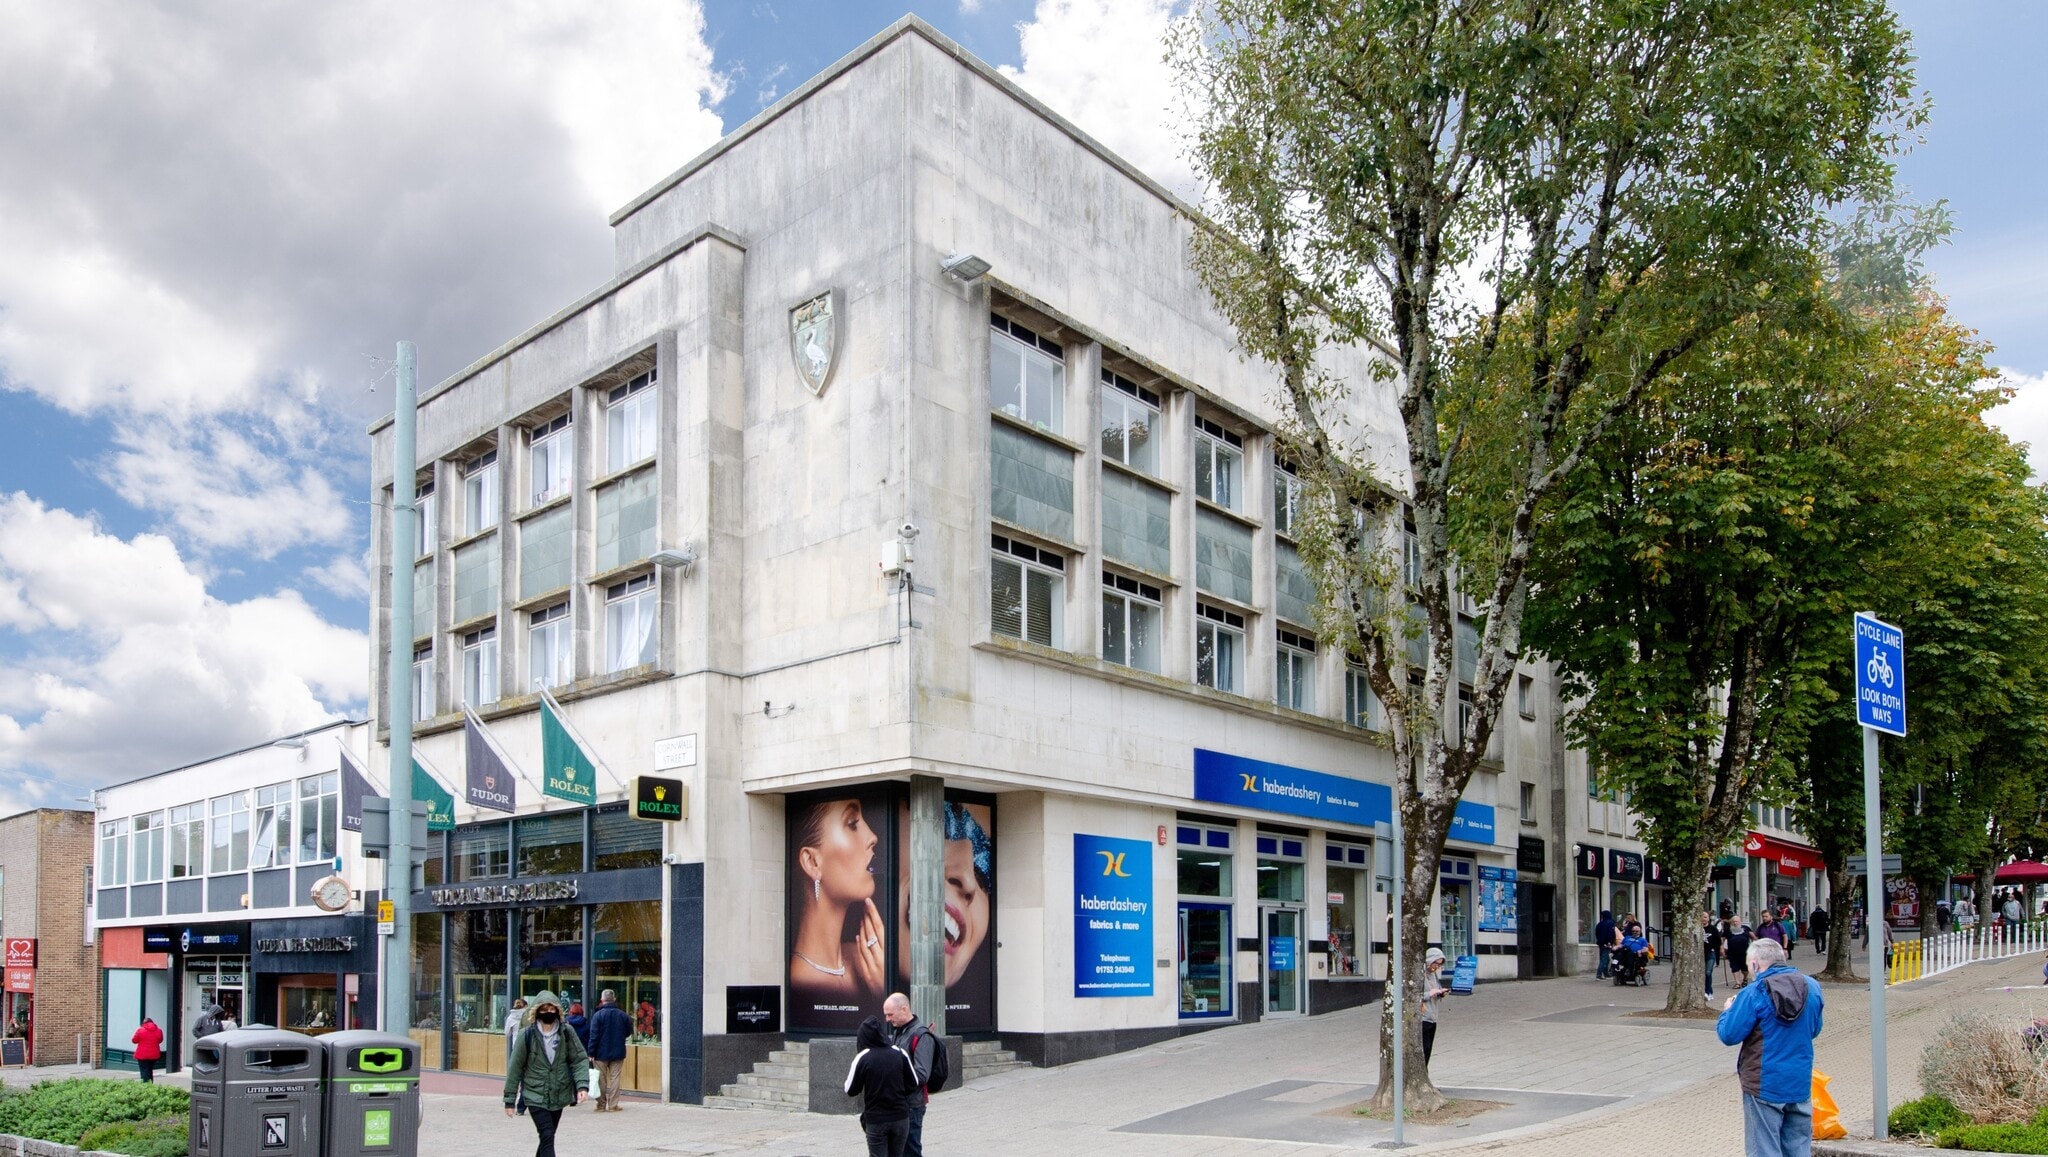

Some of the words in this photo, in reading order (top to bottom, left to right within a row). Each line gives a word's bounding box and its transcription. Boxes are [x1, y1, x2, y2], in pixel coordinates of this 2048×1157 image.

[1859, 621, 1881, 642] CYCLE
[1883, 631, 1901, 649] LANE
[1861, 687, 1881, 705] LOOK
[1882, 693, 1901, 710] BOTH
[1872, 706, 1892, 724] WAYS
[657, 739, 693, 754] CORNWALL
[663, 753, 686, 765] STREET
[549, 777, 591, 796] ROLEX
[1263, 777, 1321, 804] haberdashery
[1327, 796, 1342, 805] fabrics
[1343, 798, 1347, 806] &
[471, 787, 509, 805] TUDOR
[640, 801, 680, 814] ROLEX
[426, 813, 450, 823] LEX
[1784, 857, 1800, 869] Santander
[1080, 894, 1147, 915] haberdashery
[1089, 919, 1114, 930] fabrics
[1114, 920, 1121, 930] &
[1122, 922, 1140, 931] more
[1100, 953, 1131, 963] Telephone:
[1095, 965, 1114, 974] 01752
